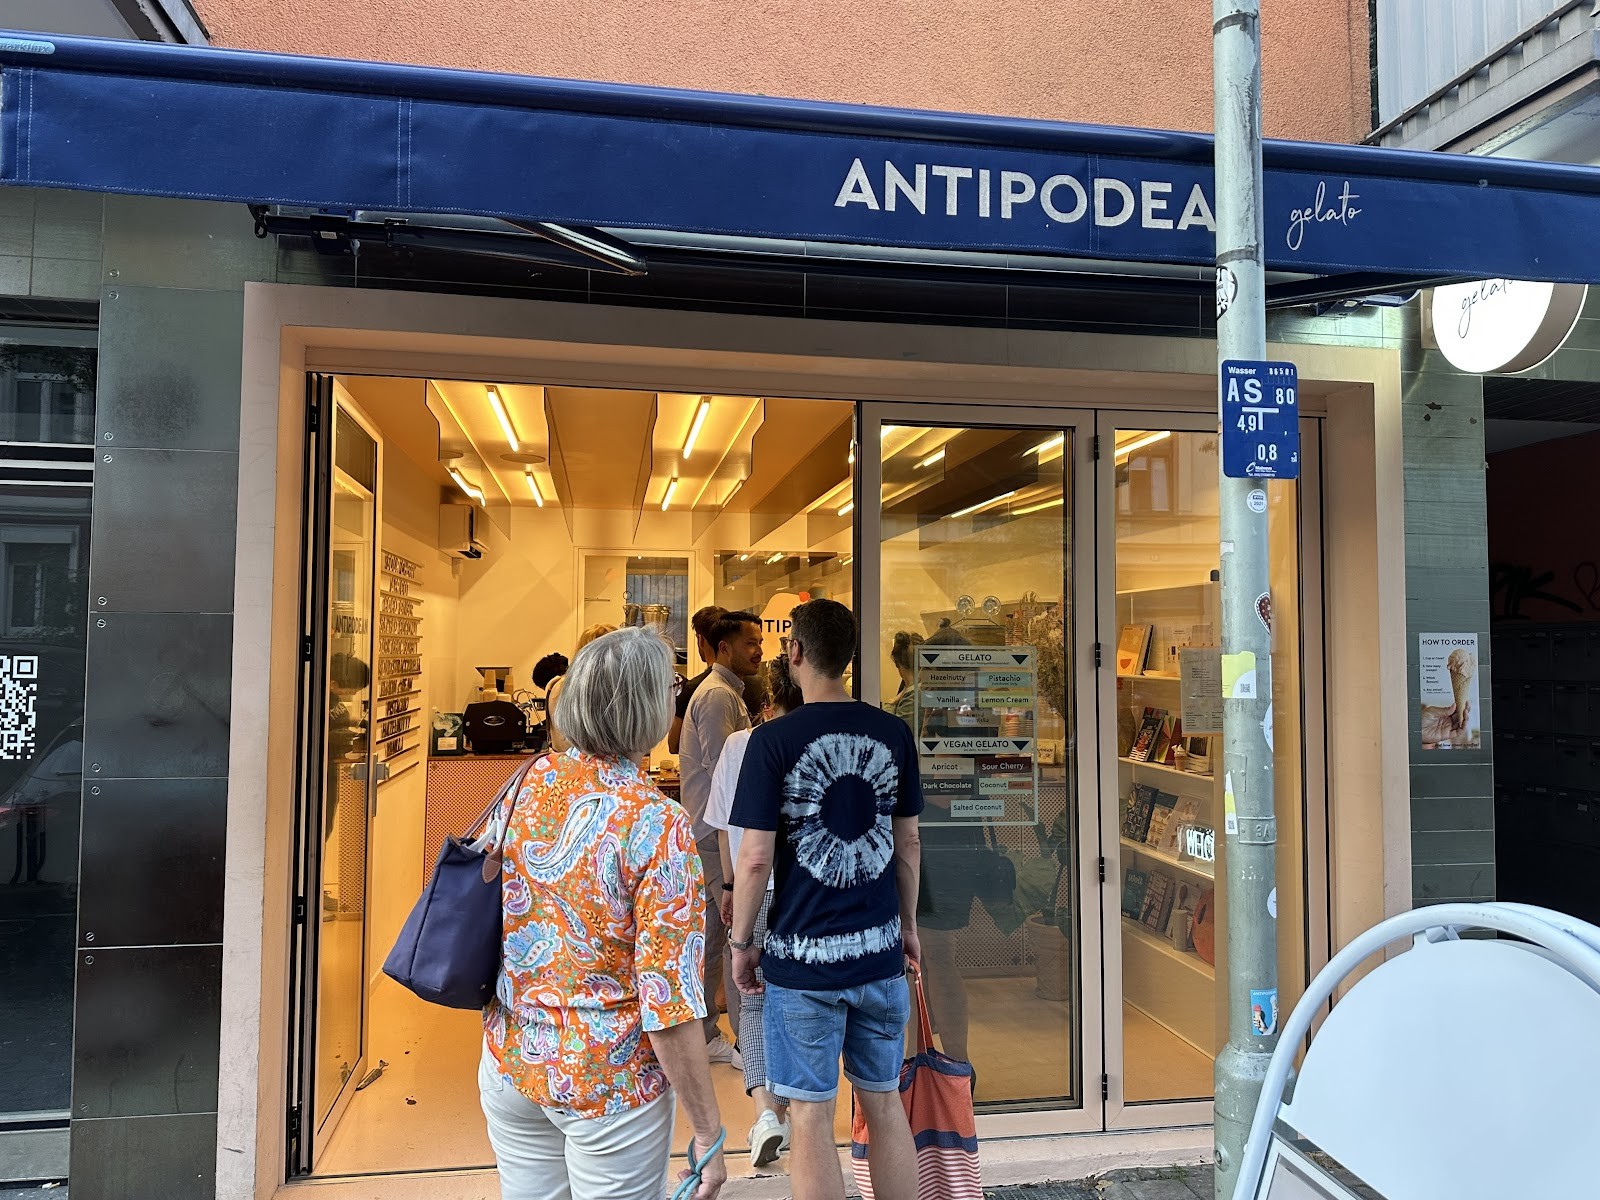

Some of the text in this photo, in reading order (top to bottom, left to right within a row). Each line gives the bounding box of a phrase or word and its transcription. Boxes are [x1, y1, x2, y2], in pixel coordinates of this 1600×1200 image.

[835, 157, 1215, 232] ANTIPODEA
[1286, 180, 1362, 251] gelato
[1228, 366, 1257, 375] Wasser
[1276, 388, 1295, 405] 80
[1237, 415, 1256, 434] 4,9
[1257, 444, 1277, 463] 0,8
[958, 653, 992, 662] GELATO
[930, 674, 966, 682] Hazelnutty
[988, 674, 1021, 682] Pistachio
[943, 740, 1009, 748] VEGAN GELATO
[931, 763, 959, 771] Apricot
[981, 762, 1024, 772] Sour Cherry
